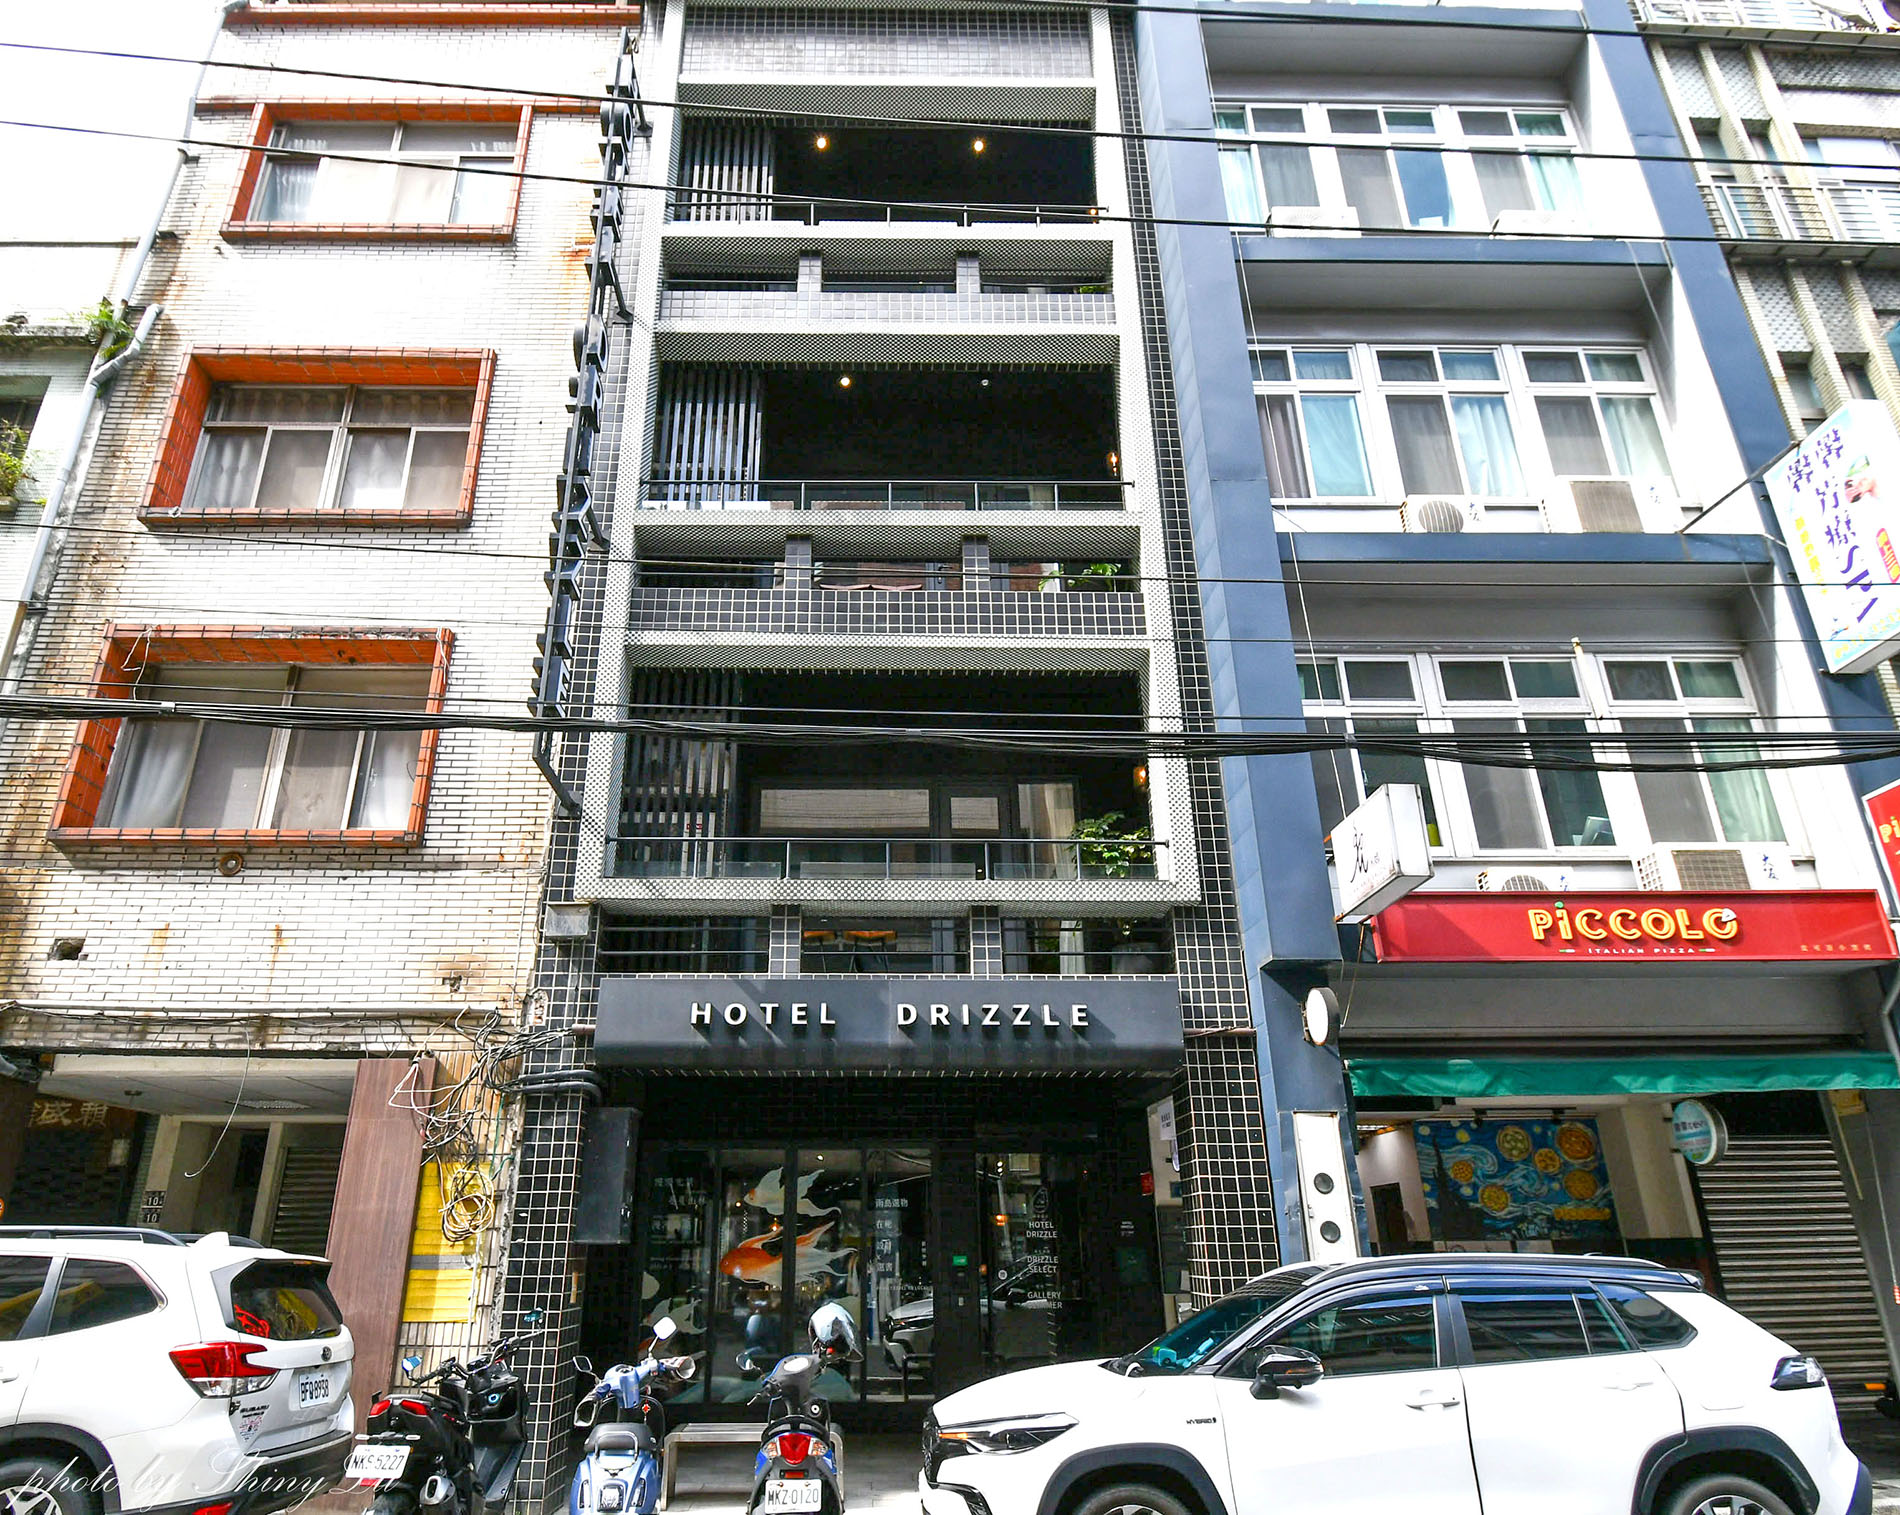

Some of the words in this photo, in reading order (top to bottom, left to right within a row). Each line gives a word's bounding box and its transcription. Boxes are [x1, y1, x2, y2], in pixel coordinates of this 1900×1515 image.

[690, 1002, 836, 1026] HOTEL
[897, 1003, 1089, 1027] DRIZZLE
[1028, 1221, 1054, 1229] HOTEL
[1026, 1230, 1058, 1238] DRIZZLE
[1027, 1255, 1059, 1264] DRIZZLE
[1028, 1265, 1057, 1273] SELECT
[1027, 1291, 1062, 1299] GALLERY
